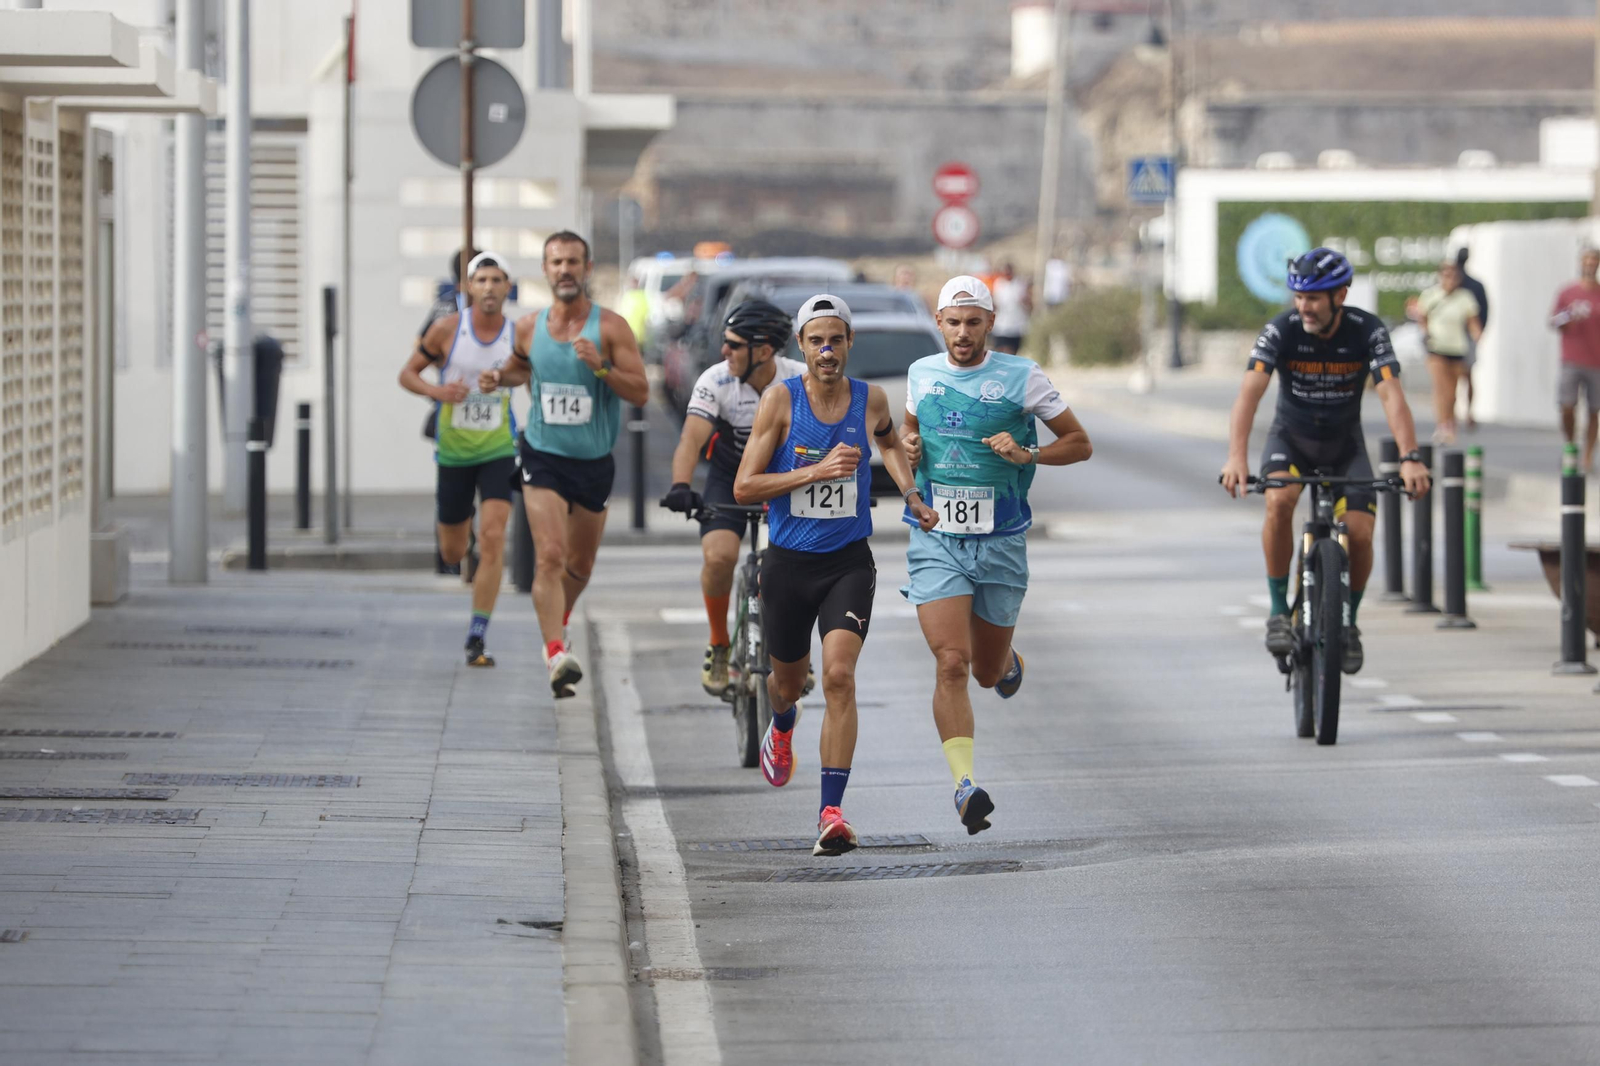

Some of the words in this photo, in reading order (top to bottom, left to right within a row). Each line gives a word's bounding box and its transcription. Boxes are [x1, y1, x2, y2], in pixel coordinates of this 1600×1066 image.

[461, 403, 491, 423] 134
[547, 396, 580, 416] 114
[805, 484, 843, 508] 121
[956, 489, 969, 500] ELA
[943, 500, 979, 524] 181
